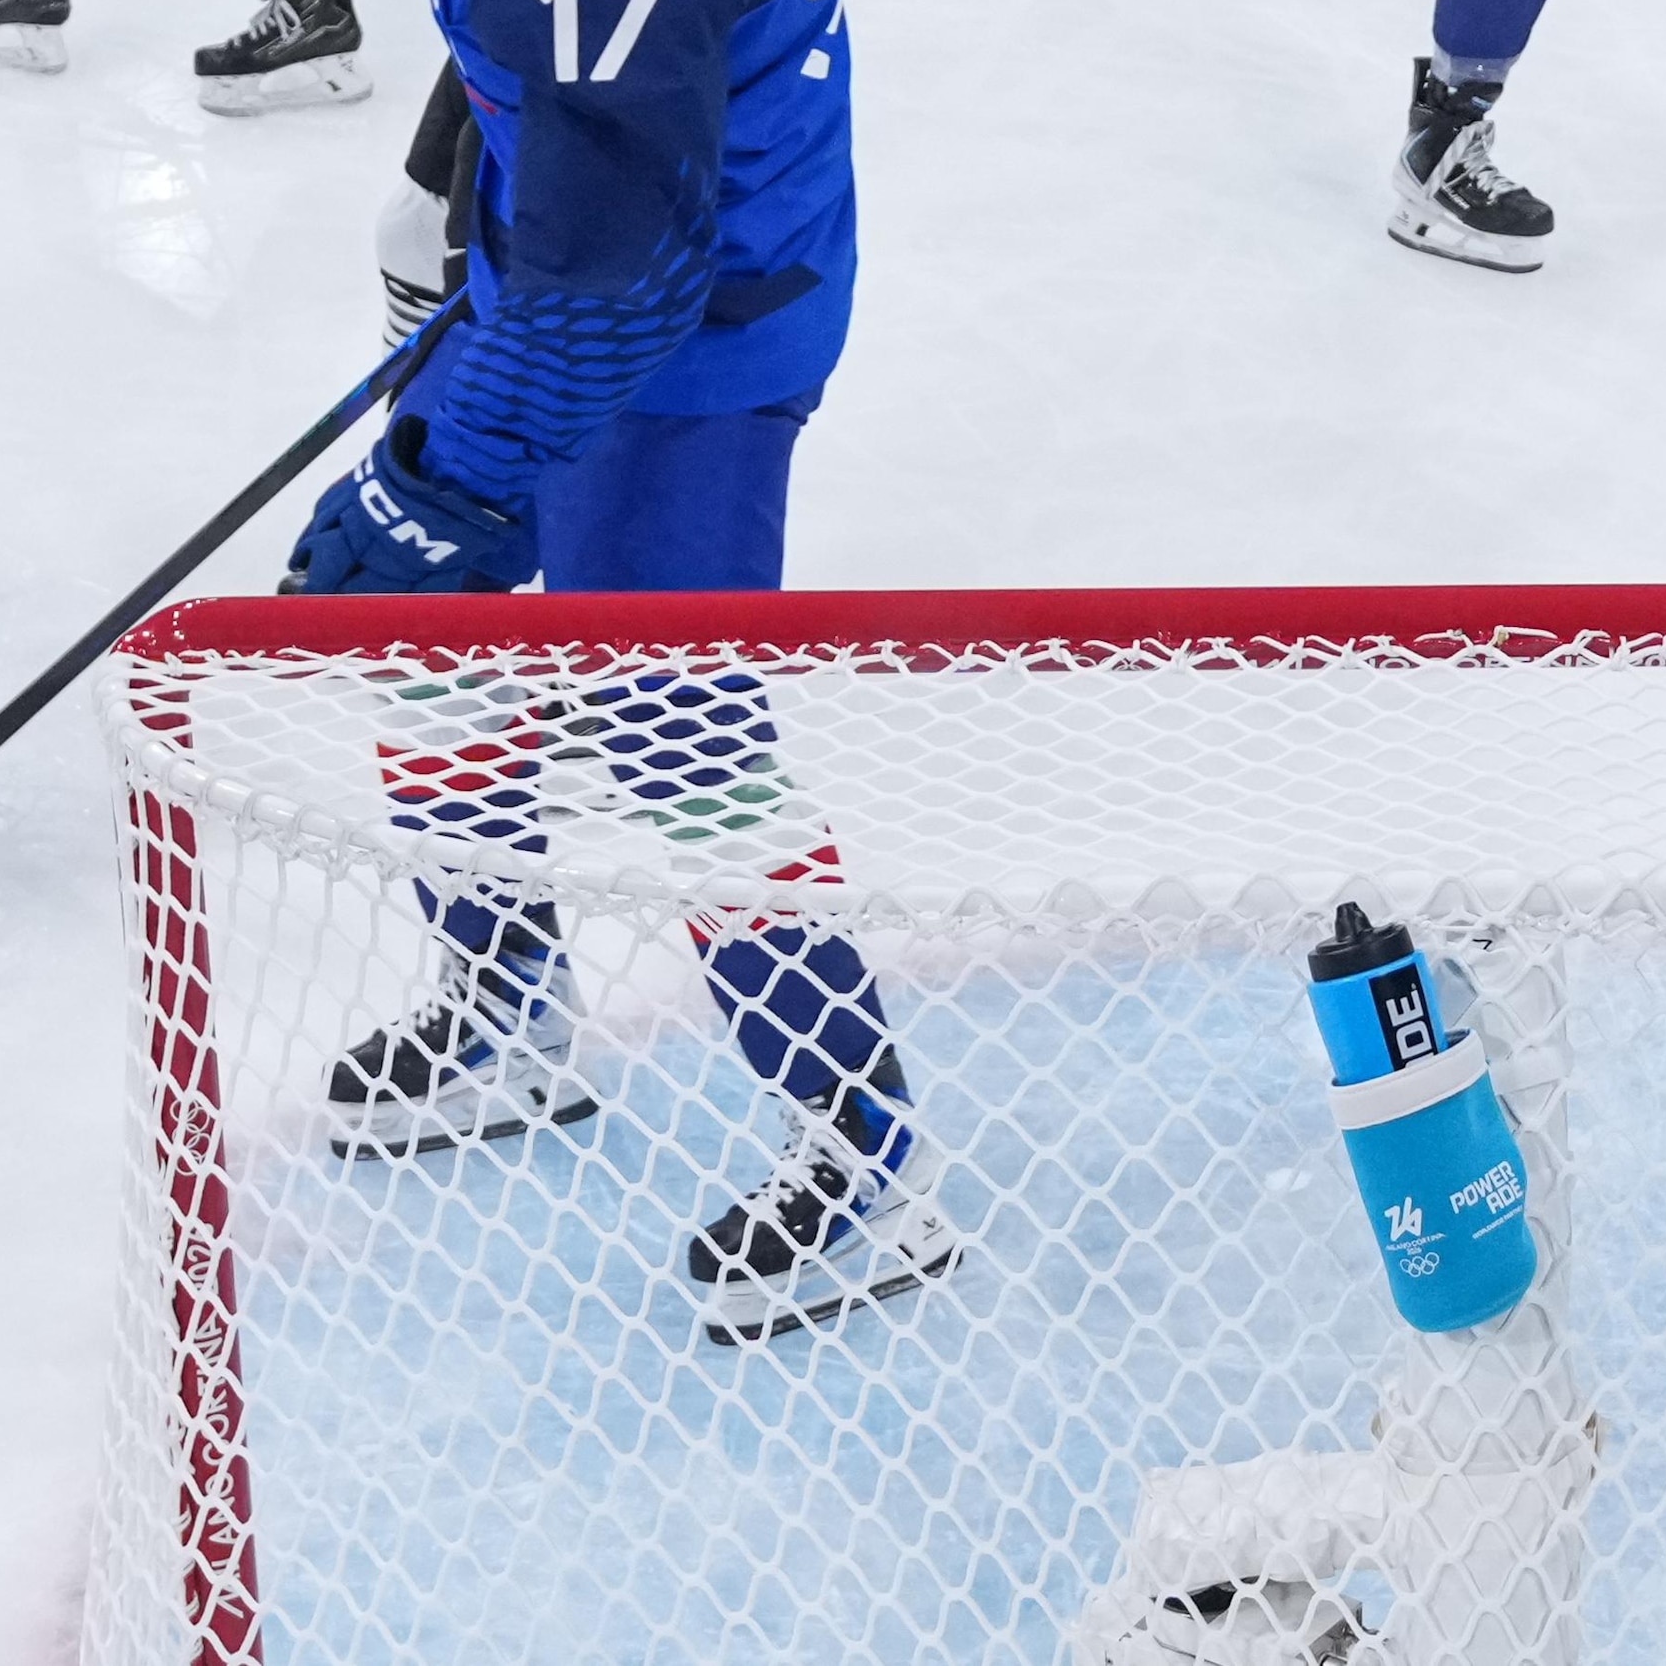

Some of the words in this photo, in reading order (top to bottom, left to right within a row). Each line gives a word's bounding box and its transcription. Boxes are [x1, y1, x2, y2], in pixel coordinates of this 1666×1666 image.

[1385, 987, 1435, 1069] DE
[1449, 1160, 1516, 1215] POWER
[1485, 1177, 1524, 1214] ADE
